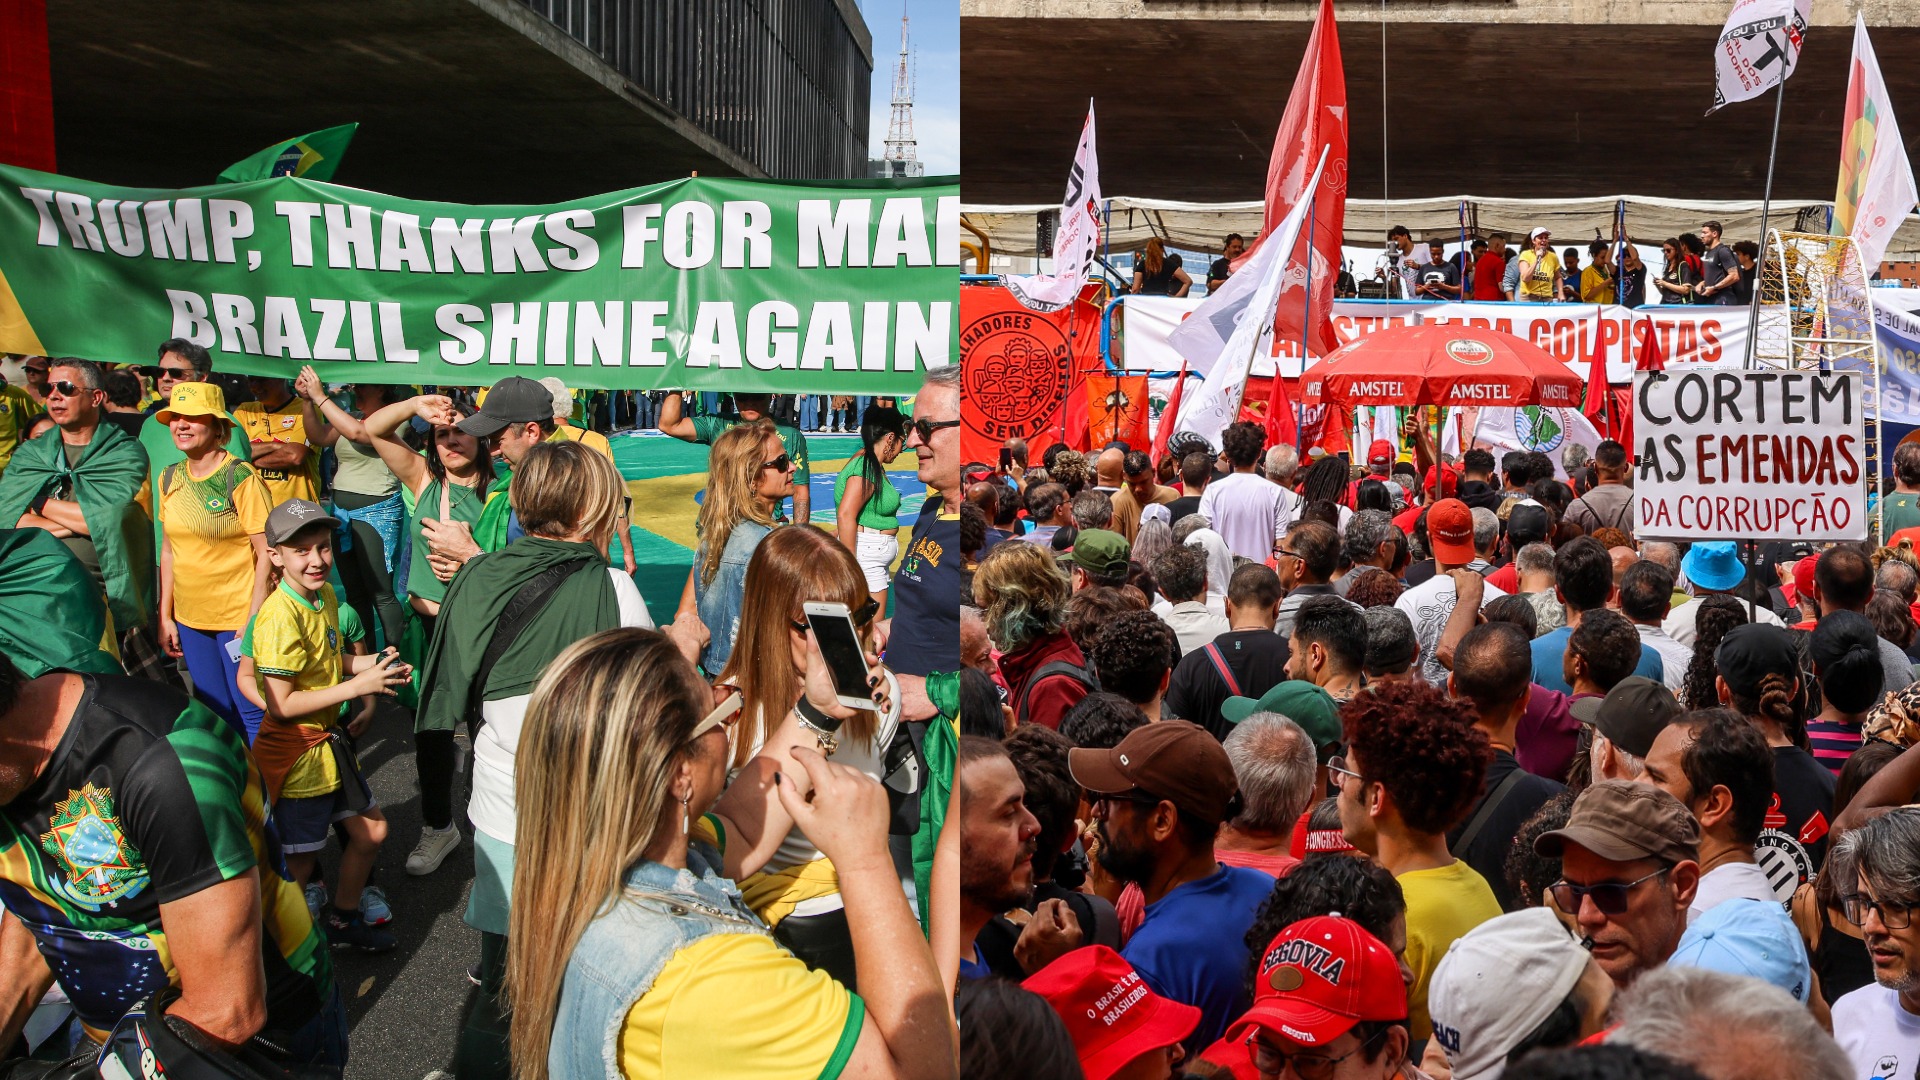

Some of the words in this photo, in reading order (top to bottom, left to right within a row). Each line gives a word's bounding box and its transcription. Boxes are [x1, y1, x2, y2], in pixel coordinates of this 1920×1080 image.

[1742, 58, 1762, 86] DOS
[20, 187, 261, 272] TRUMP,
[275, 201, 600, 274] THANKS
[621, 201, 773, 270] FOR
[166, 289, 420, 363] BRAZIL
[435, 301, 669, 367] SHINE
[686, 301, 952, 372] AGAIN
[1349, 381, 1403, 396] AMSTEL
[1450, 384, 1511, 399] AMSTEL
[1542, 384, 1569, 400] AMSTEL
[1639, 373, 1851, 425] CORTEM
[983, 420, 1025, 438] SEM
[264, 469, 283, 479] LULA
[1640, 434, 1687, 483] AS
[1696, 434, 1859, 485] EMENDAS
[1641, 497, 1672, 527] DA
[1678, 492, 1851, 534] CORRUPÇÃO
[1305, 831, 1353, 850] #CONGRESS
[1263, 939, 1346, 986] SEGOVIA
[1087, 1008, 1096, 1019] O
[1095, 983, 1126, 1011] BRASIL
[1120, 976, 1131, 987] É
[1103, 984, 1148, 1026] BRASILEIROS
